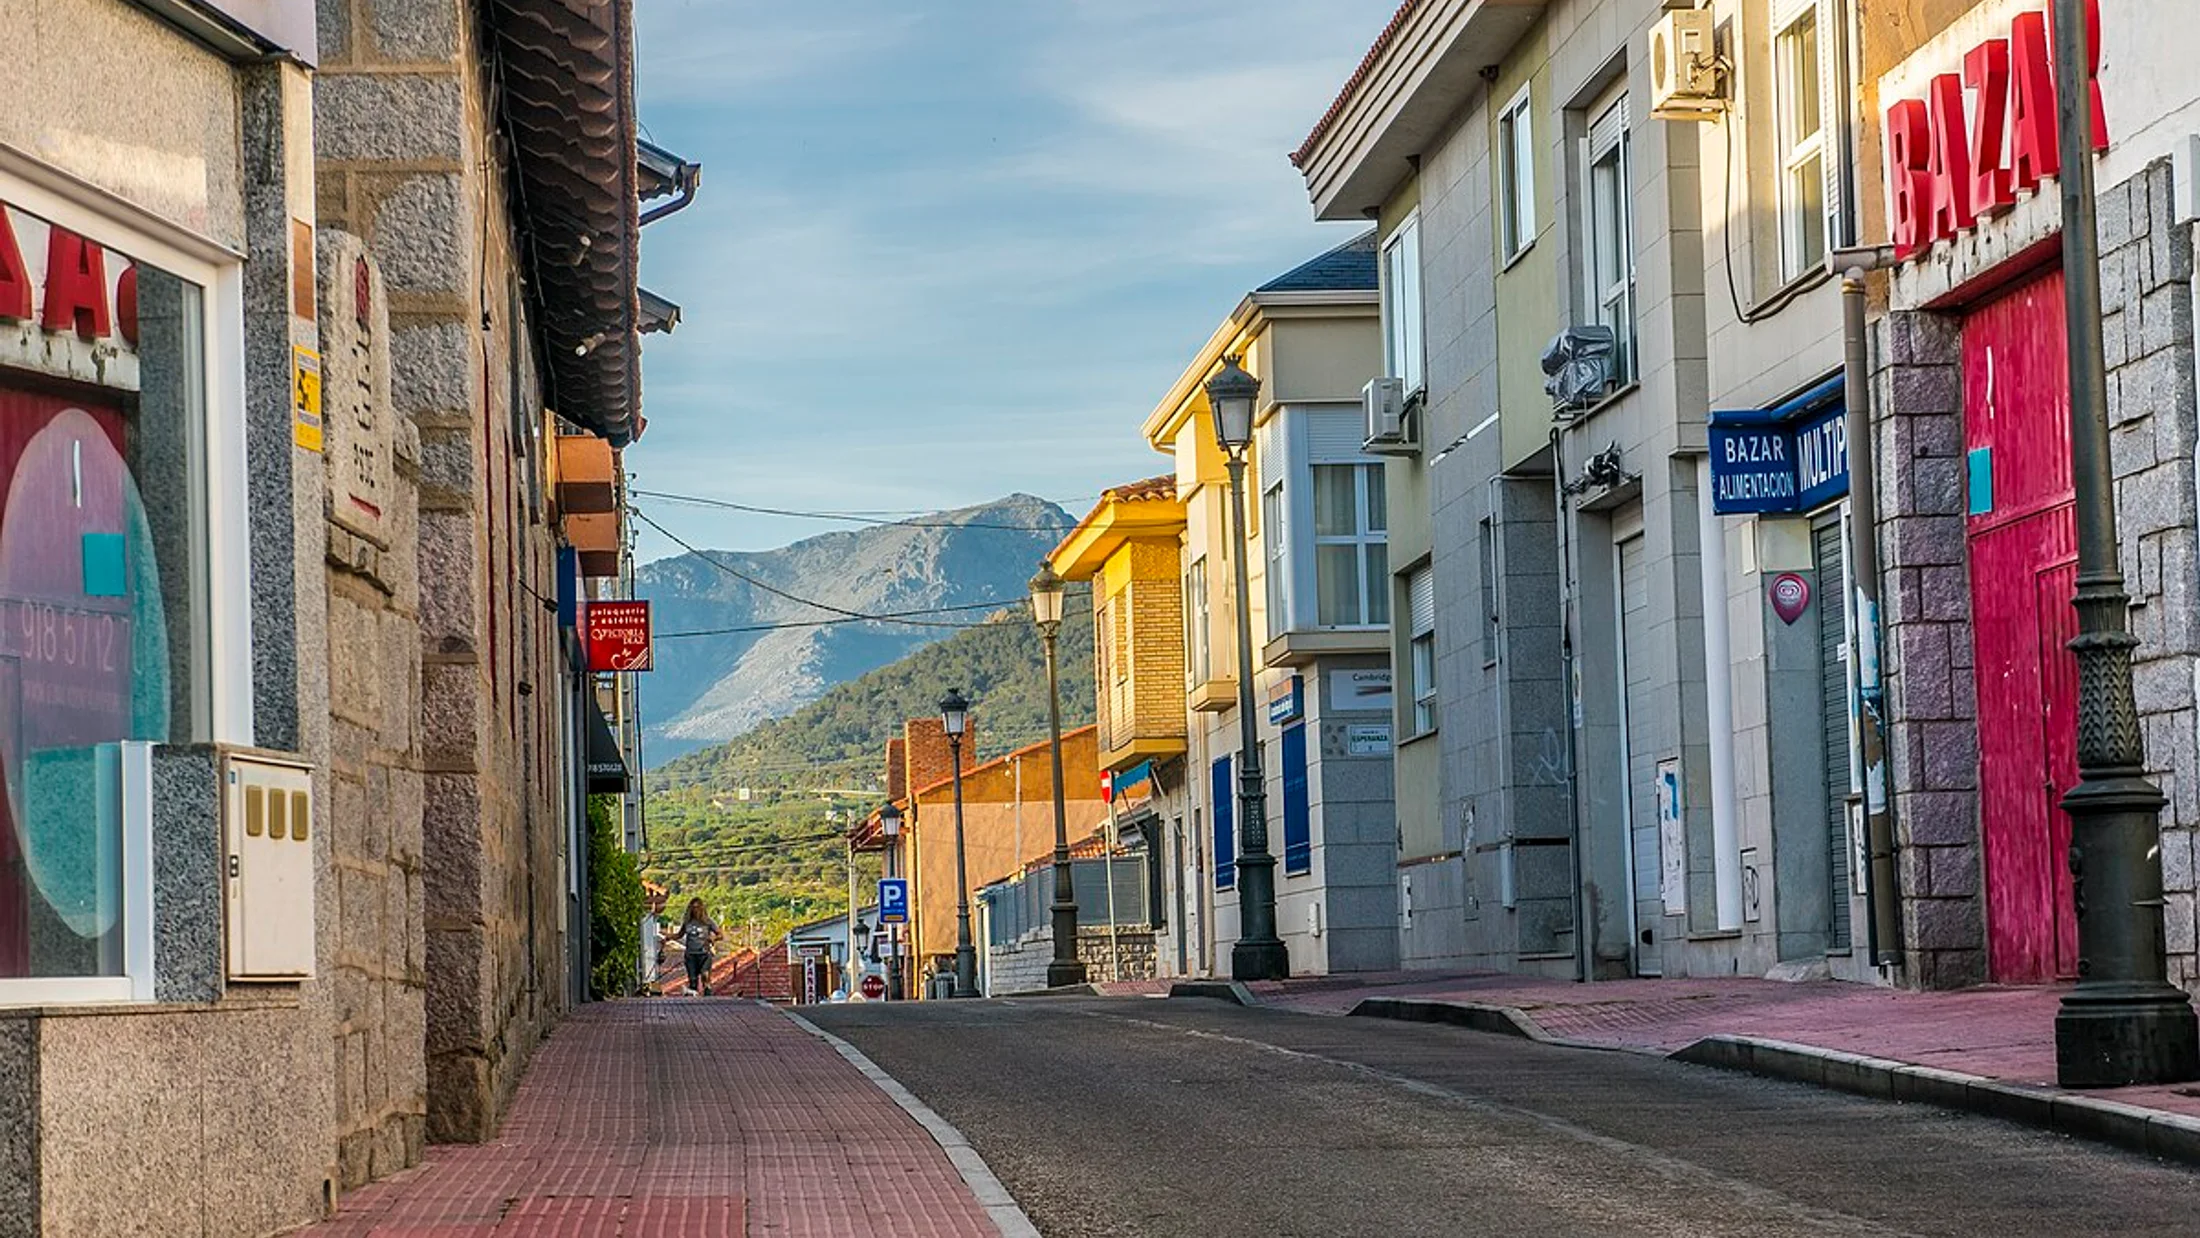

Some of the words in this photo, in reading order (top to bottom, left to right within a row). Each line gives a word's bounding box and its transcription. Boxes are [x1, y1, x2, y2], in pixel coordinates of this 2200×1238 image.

[1725, 435, 1785, 463] BAZAR
[1719, 471, 1795, 500] ALIMENTACION
[22, 599, 57, 662] 918
[883, 885, 902, 907] P
[863, 983, 885, 991] STOP
